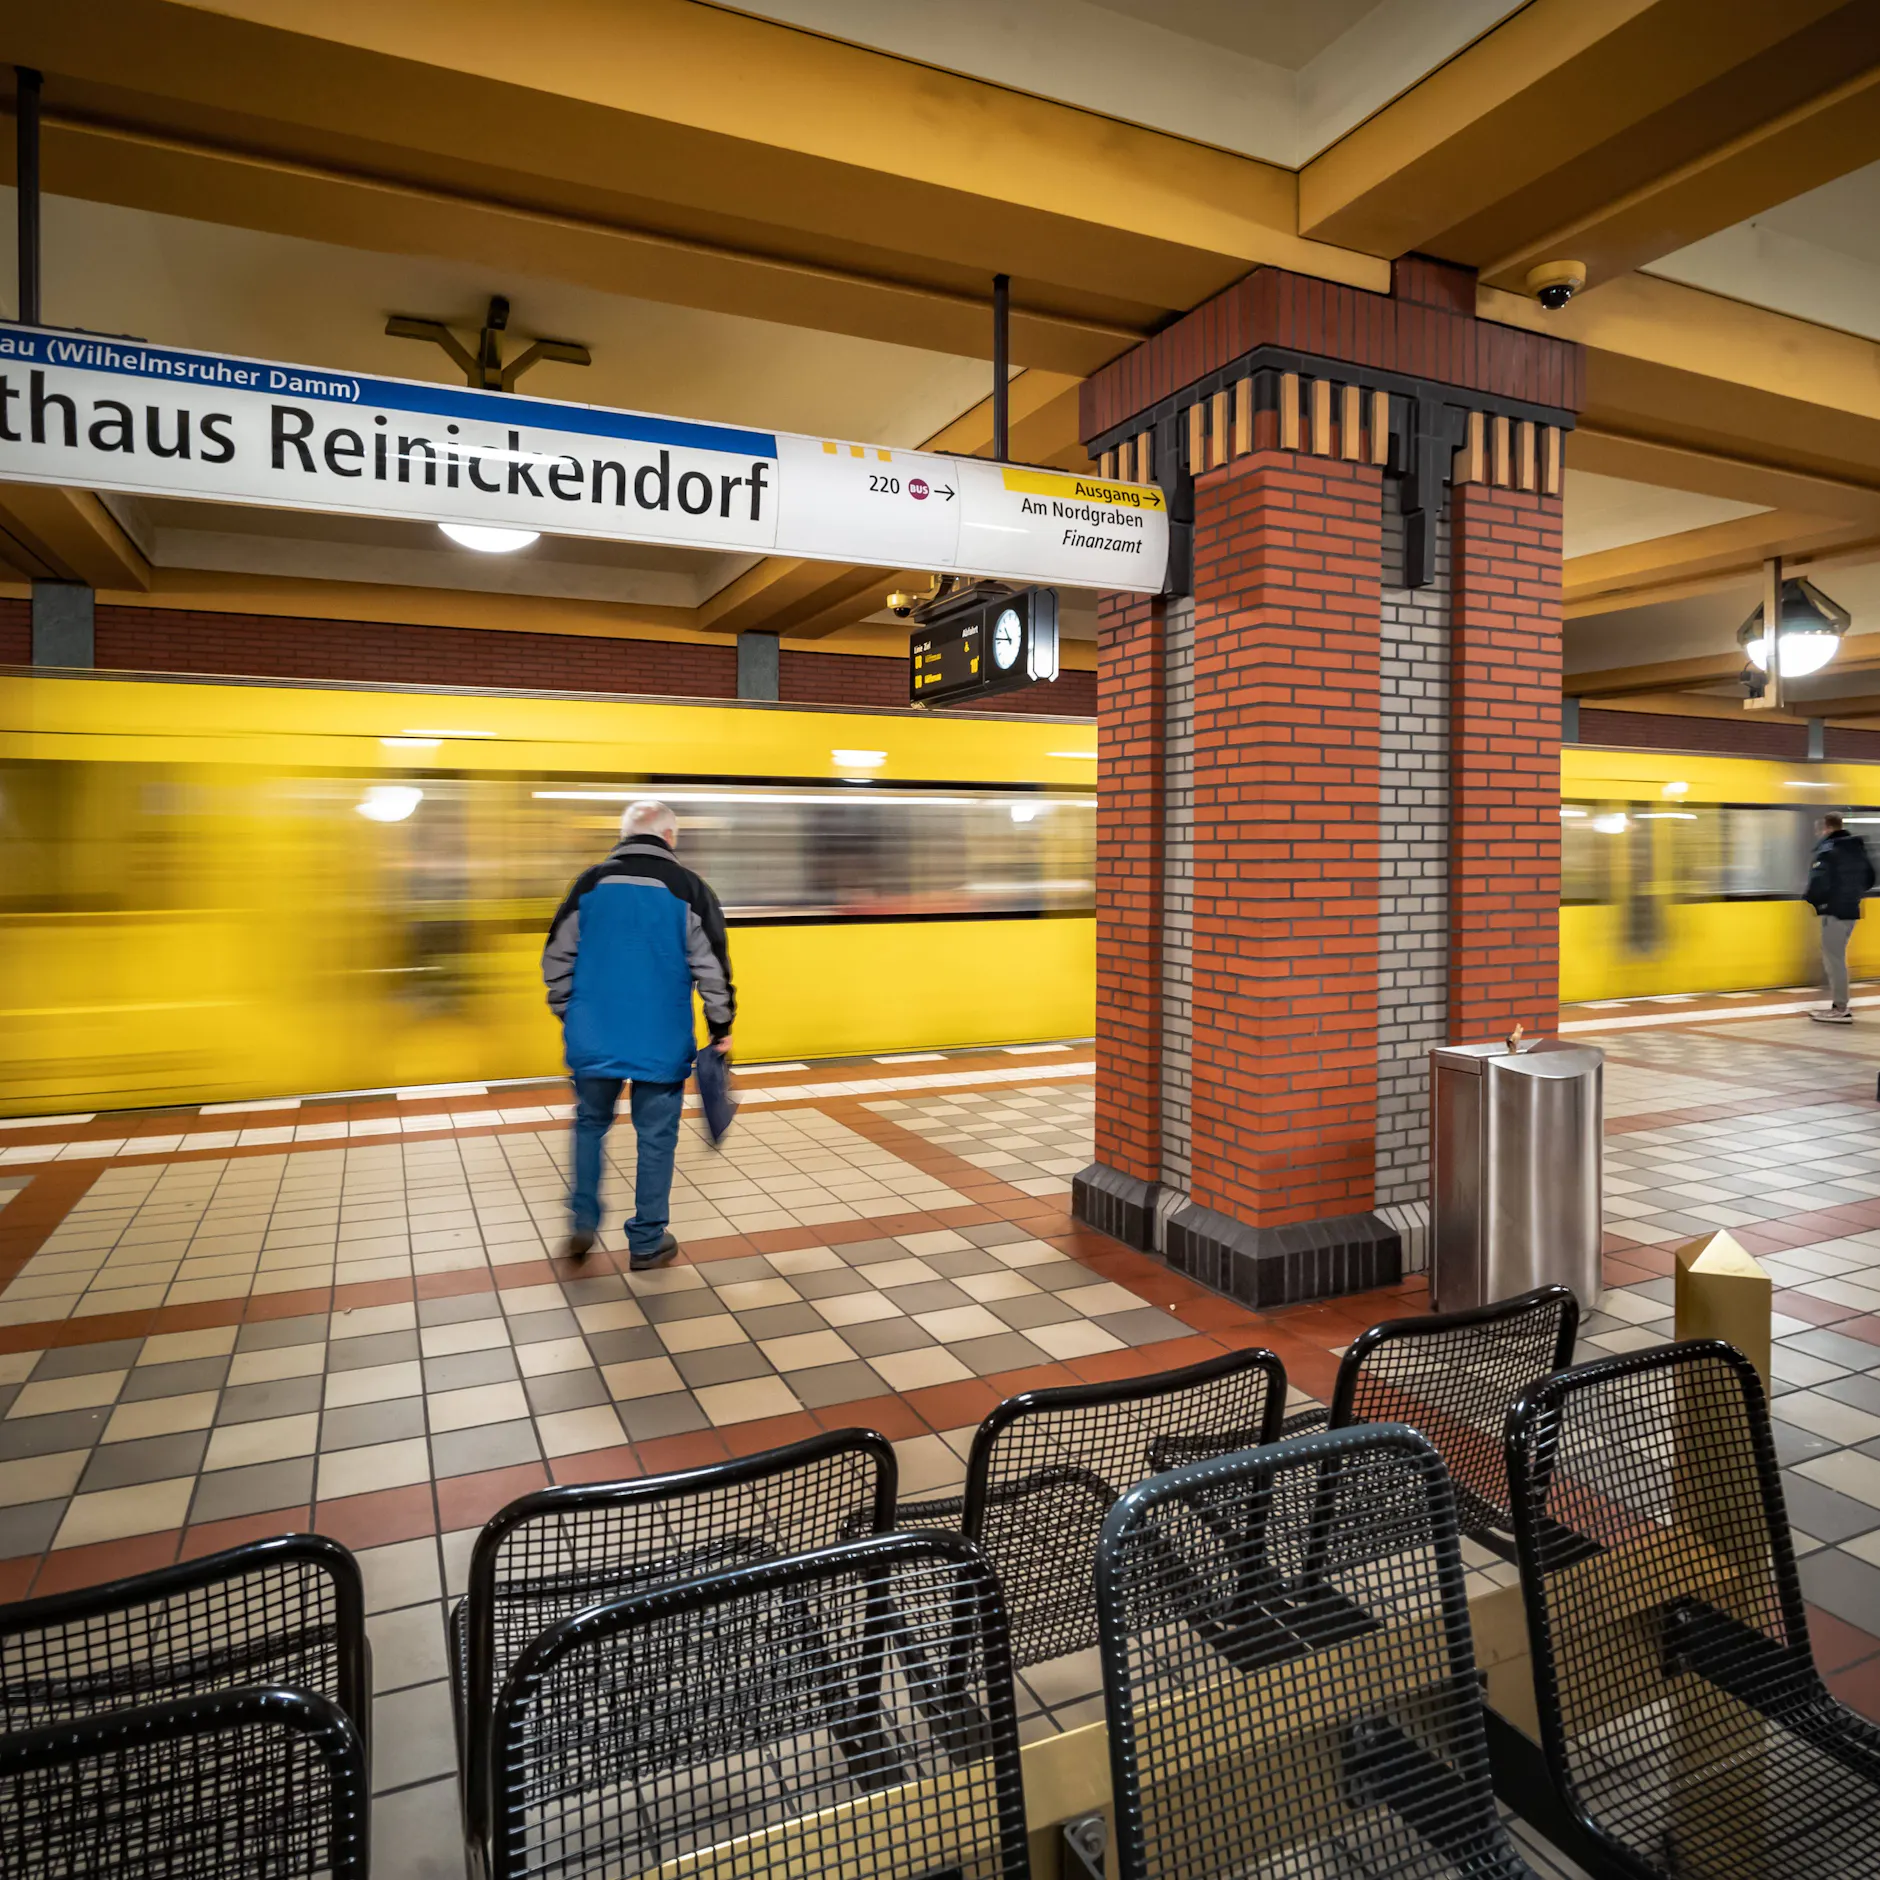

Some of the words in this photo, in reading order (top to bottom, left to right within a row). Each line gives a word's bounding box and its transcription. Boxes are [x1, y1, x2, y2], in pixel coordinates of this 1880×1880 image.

[0, 338, 35, 357] au
[46, 339, 261, 386] (Wilhelmsruher
[269, 370, 362, 402] Damm)
[0, 369, 236, 464] thaus
[270, 404, 769, 522] Reinickendorf
[869, 475, 900, 494] 220
[910, 484, 929, 495] BUS
[1075, 482, 1141, 507] Ausgang
[1021, 498, 1048, 516] Am
[1052, 501, 1143, 528] Nordgraben
[1062, 529, 1143, 554] Finanzamt
